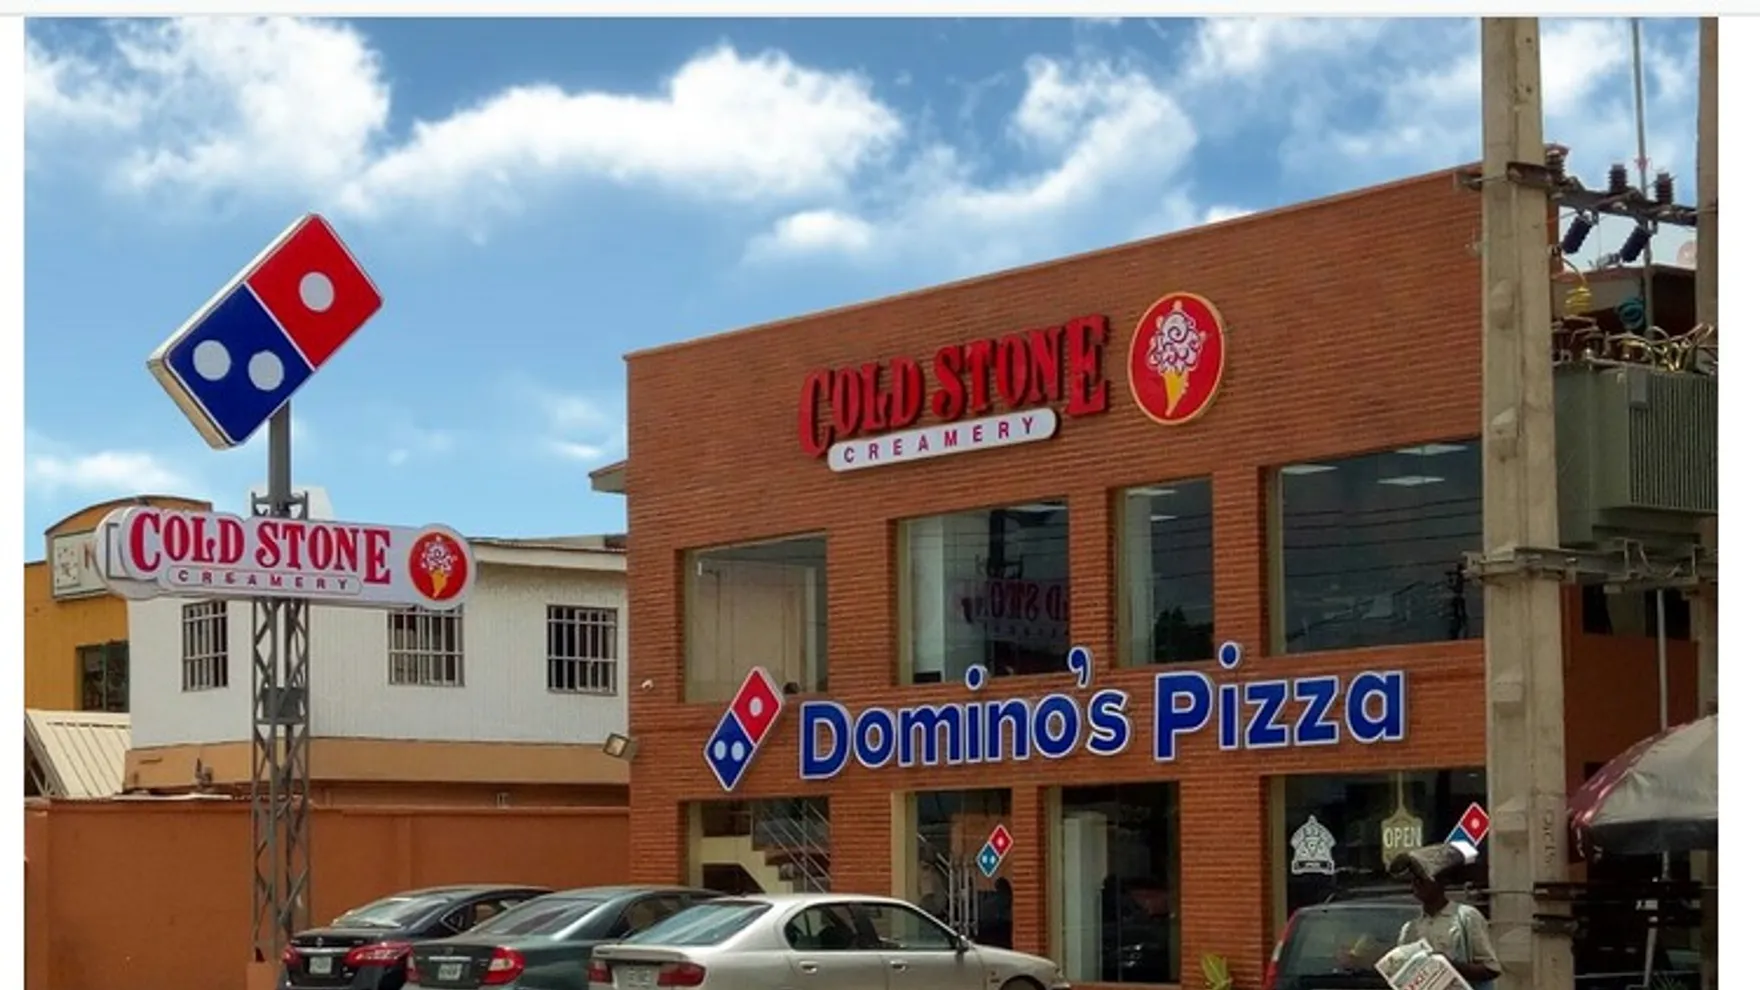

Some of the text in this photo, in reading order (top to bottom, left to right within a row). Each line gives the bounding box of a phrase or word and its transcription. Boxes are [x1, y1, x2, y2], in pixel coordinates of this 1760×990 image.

[801, 314, 1109, 459] COLD STONE
[843, 415, 1037, 463] CREAMERY
[129, 512, 245, 573] COLD
[255, 521, 391, 584] STONE
[177, 569, 348, 590] CREAMERY
[799, 641, 1408, 780] Domino's Pizza
[1382, 826, 1422, 849] OPEN
